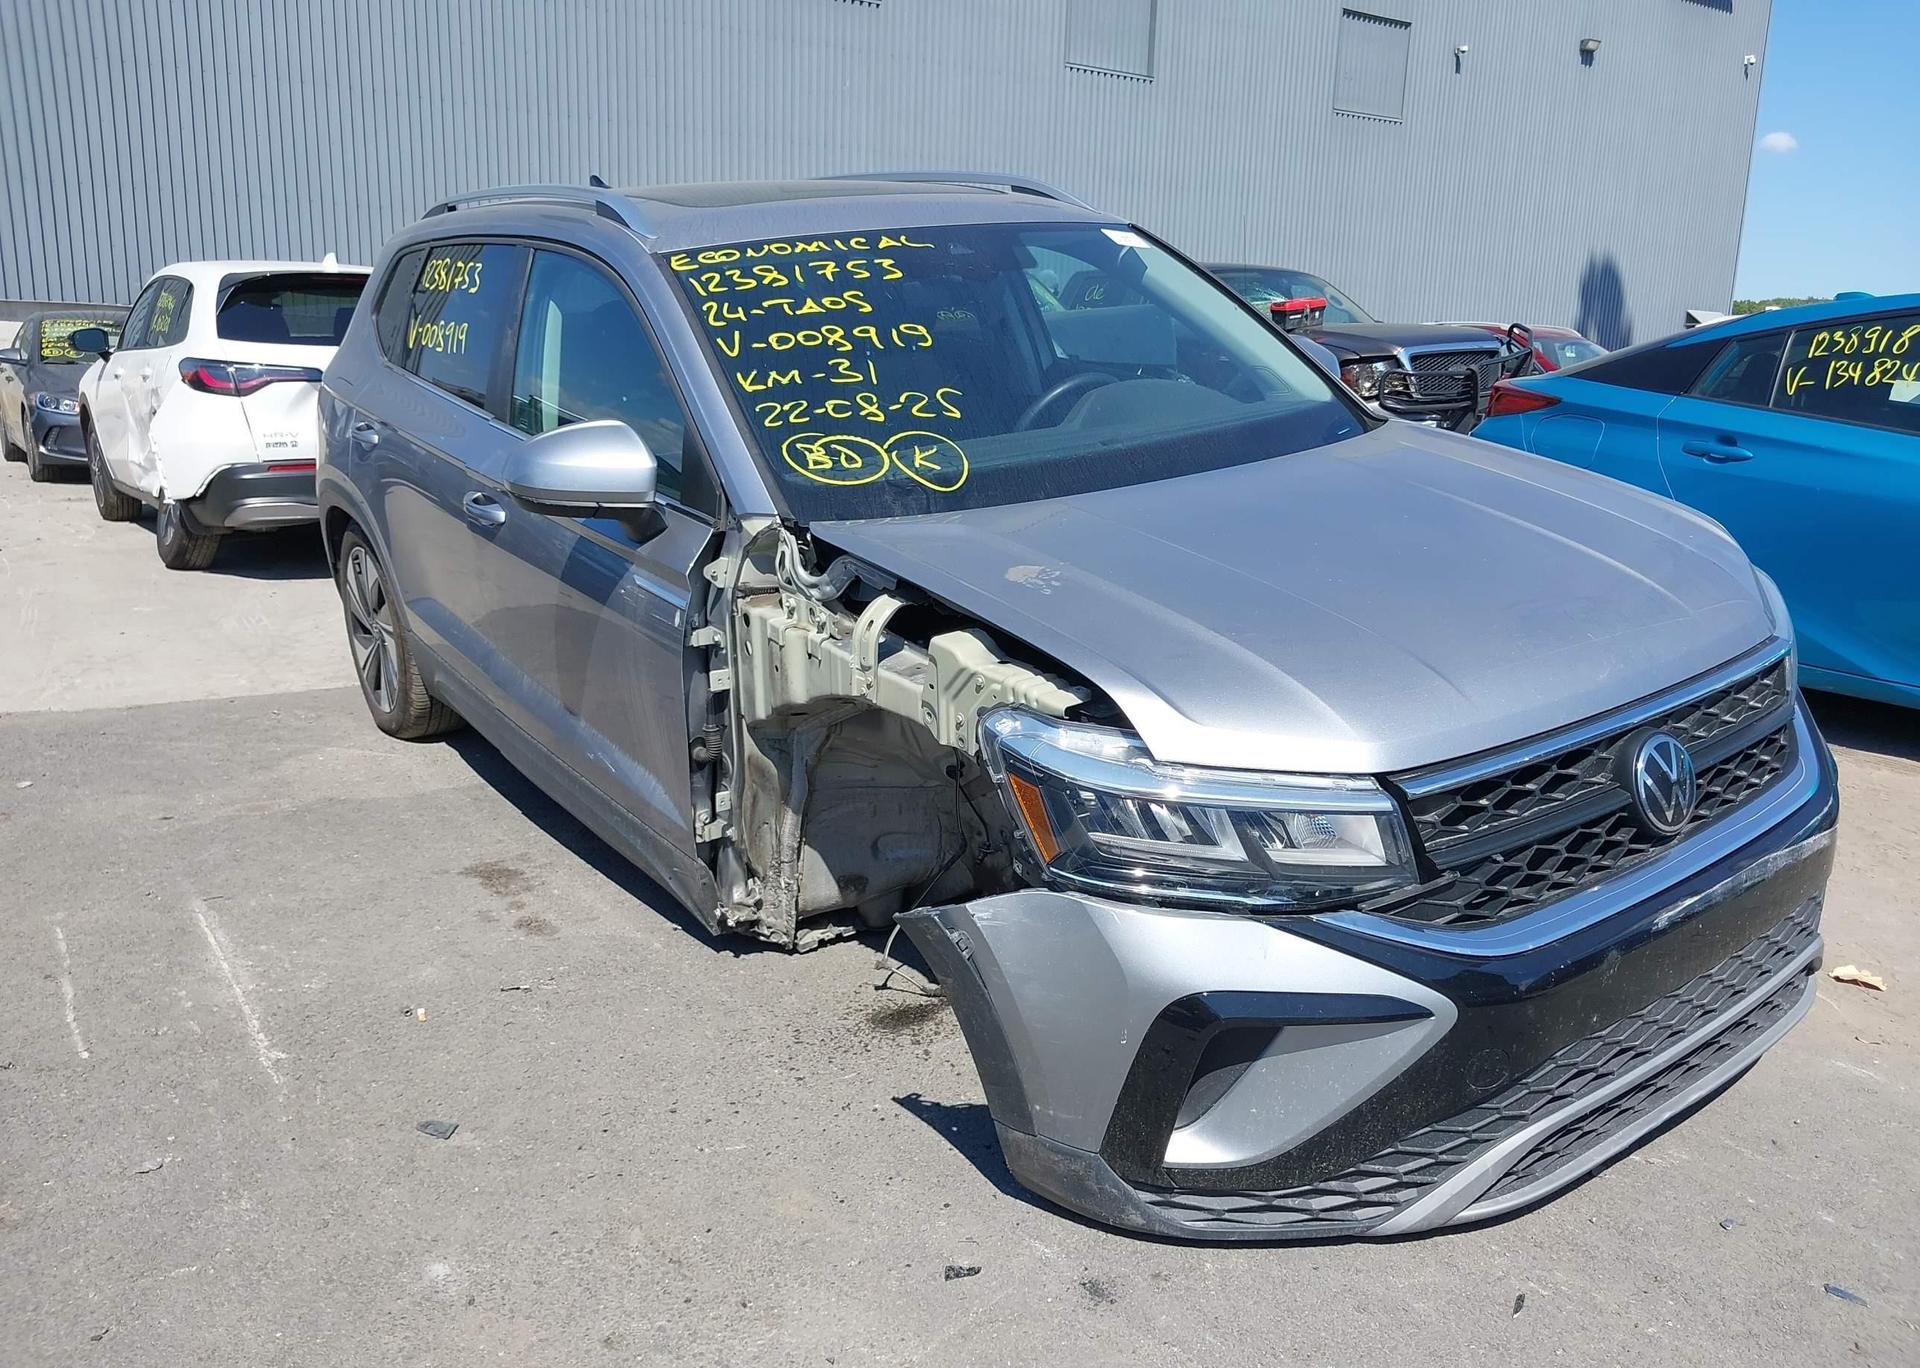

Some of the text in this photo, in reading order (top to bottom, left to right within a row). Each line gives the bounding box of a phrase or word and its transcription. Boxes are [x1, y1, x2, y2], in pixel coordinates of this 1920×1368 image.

[670, 236, 935, 270] ECONOMICAL
[422, 258, 482, 293] 12381753
[689, 259, 903, 296] 12381753
[755, 387, 963, 428] 22-08-25
